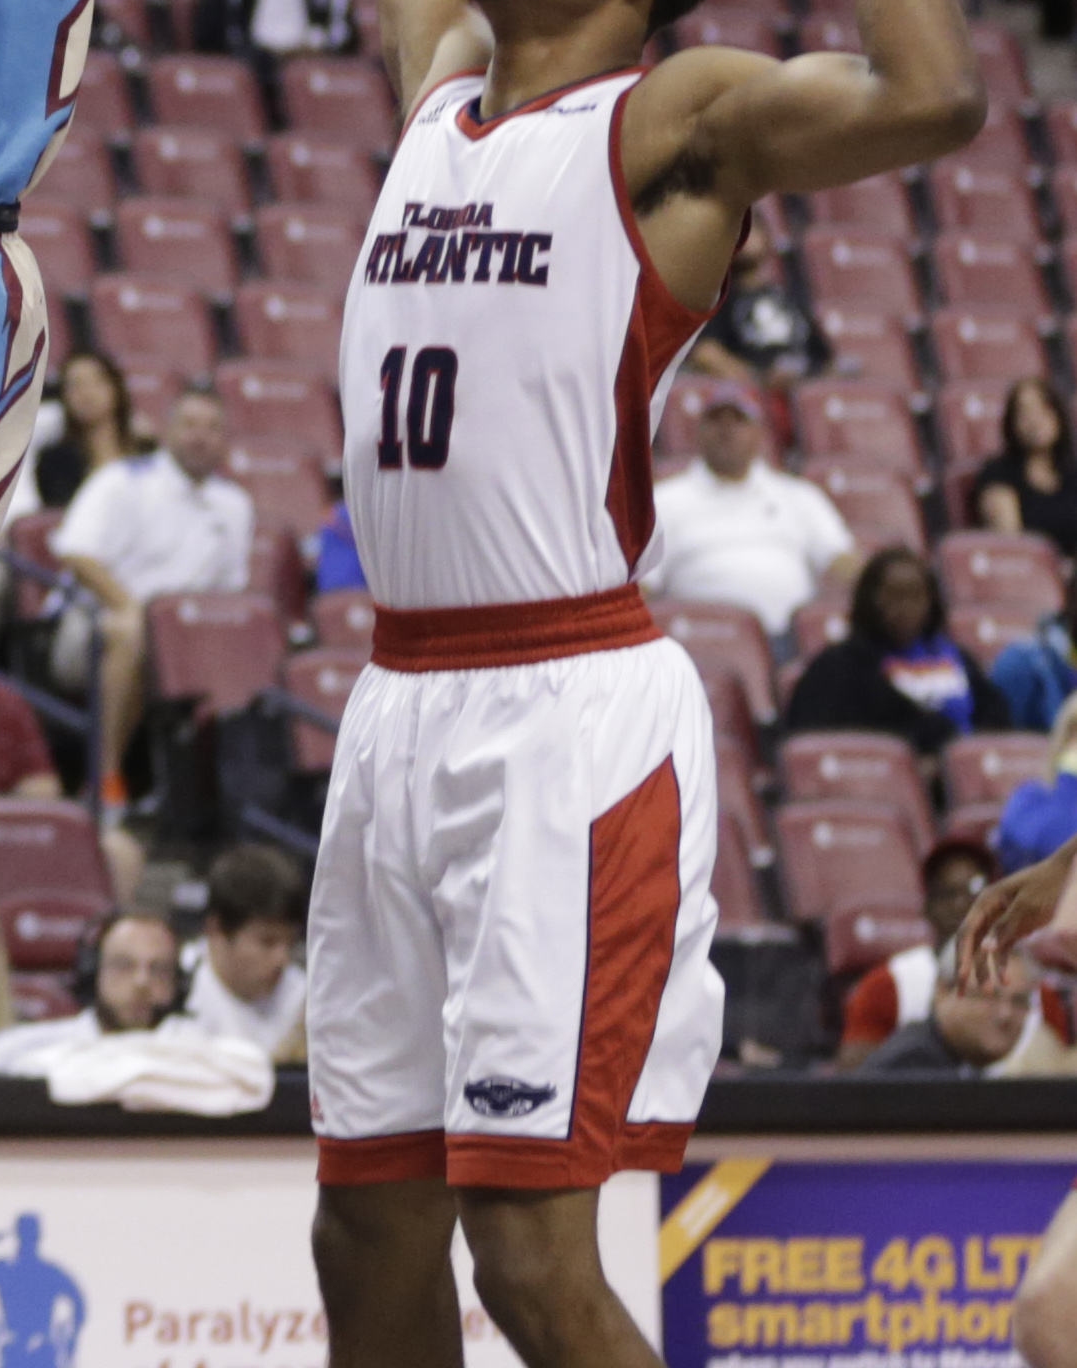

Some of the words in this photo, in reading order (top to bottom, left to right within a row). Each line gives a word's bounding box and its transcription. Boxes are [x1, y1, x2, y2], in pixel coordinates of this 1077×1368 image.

[364, 232, 552, 288] ATLANTIC
[378, 344, 458, 470] 10
[703, 1237, 865, 1295] FREE
[872, 1235, 957, 1293] 4G
